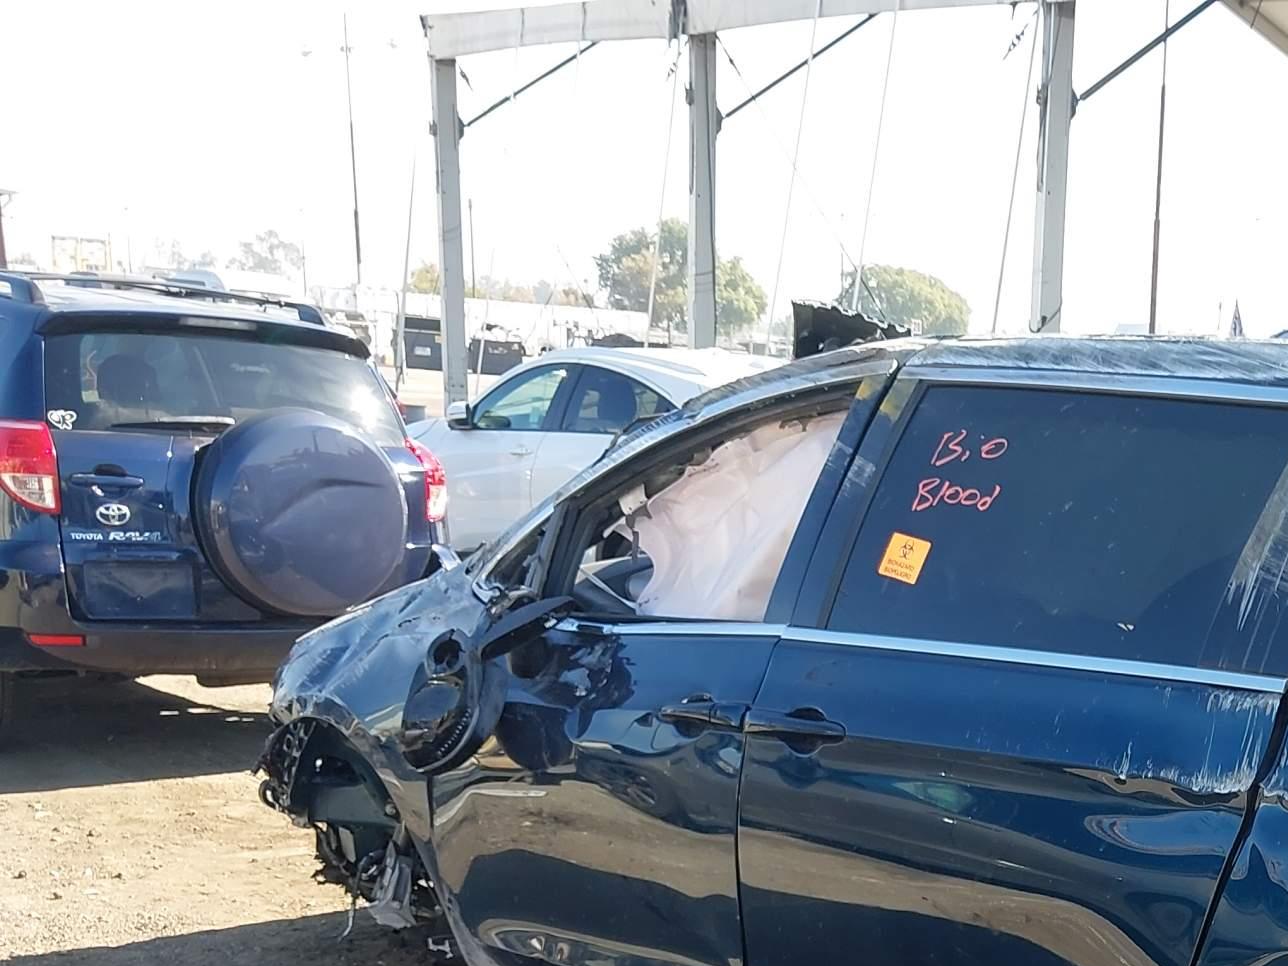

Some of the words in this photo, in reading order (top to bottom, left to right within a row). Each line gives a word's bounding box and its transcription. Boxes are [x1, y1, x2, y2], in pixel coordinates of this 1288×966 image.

[912, 478, 1001, 511] Blood
[70, 532, 103, 541] TOYOTA
[108, 531, 161, 541] RAV4
